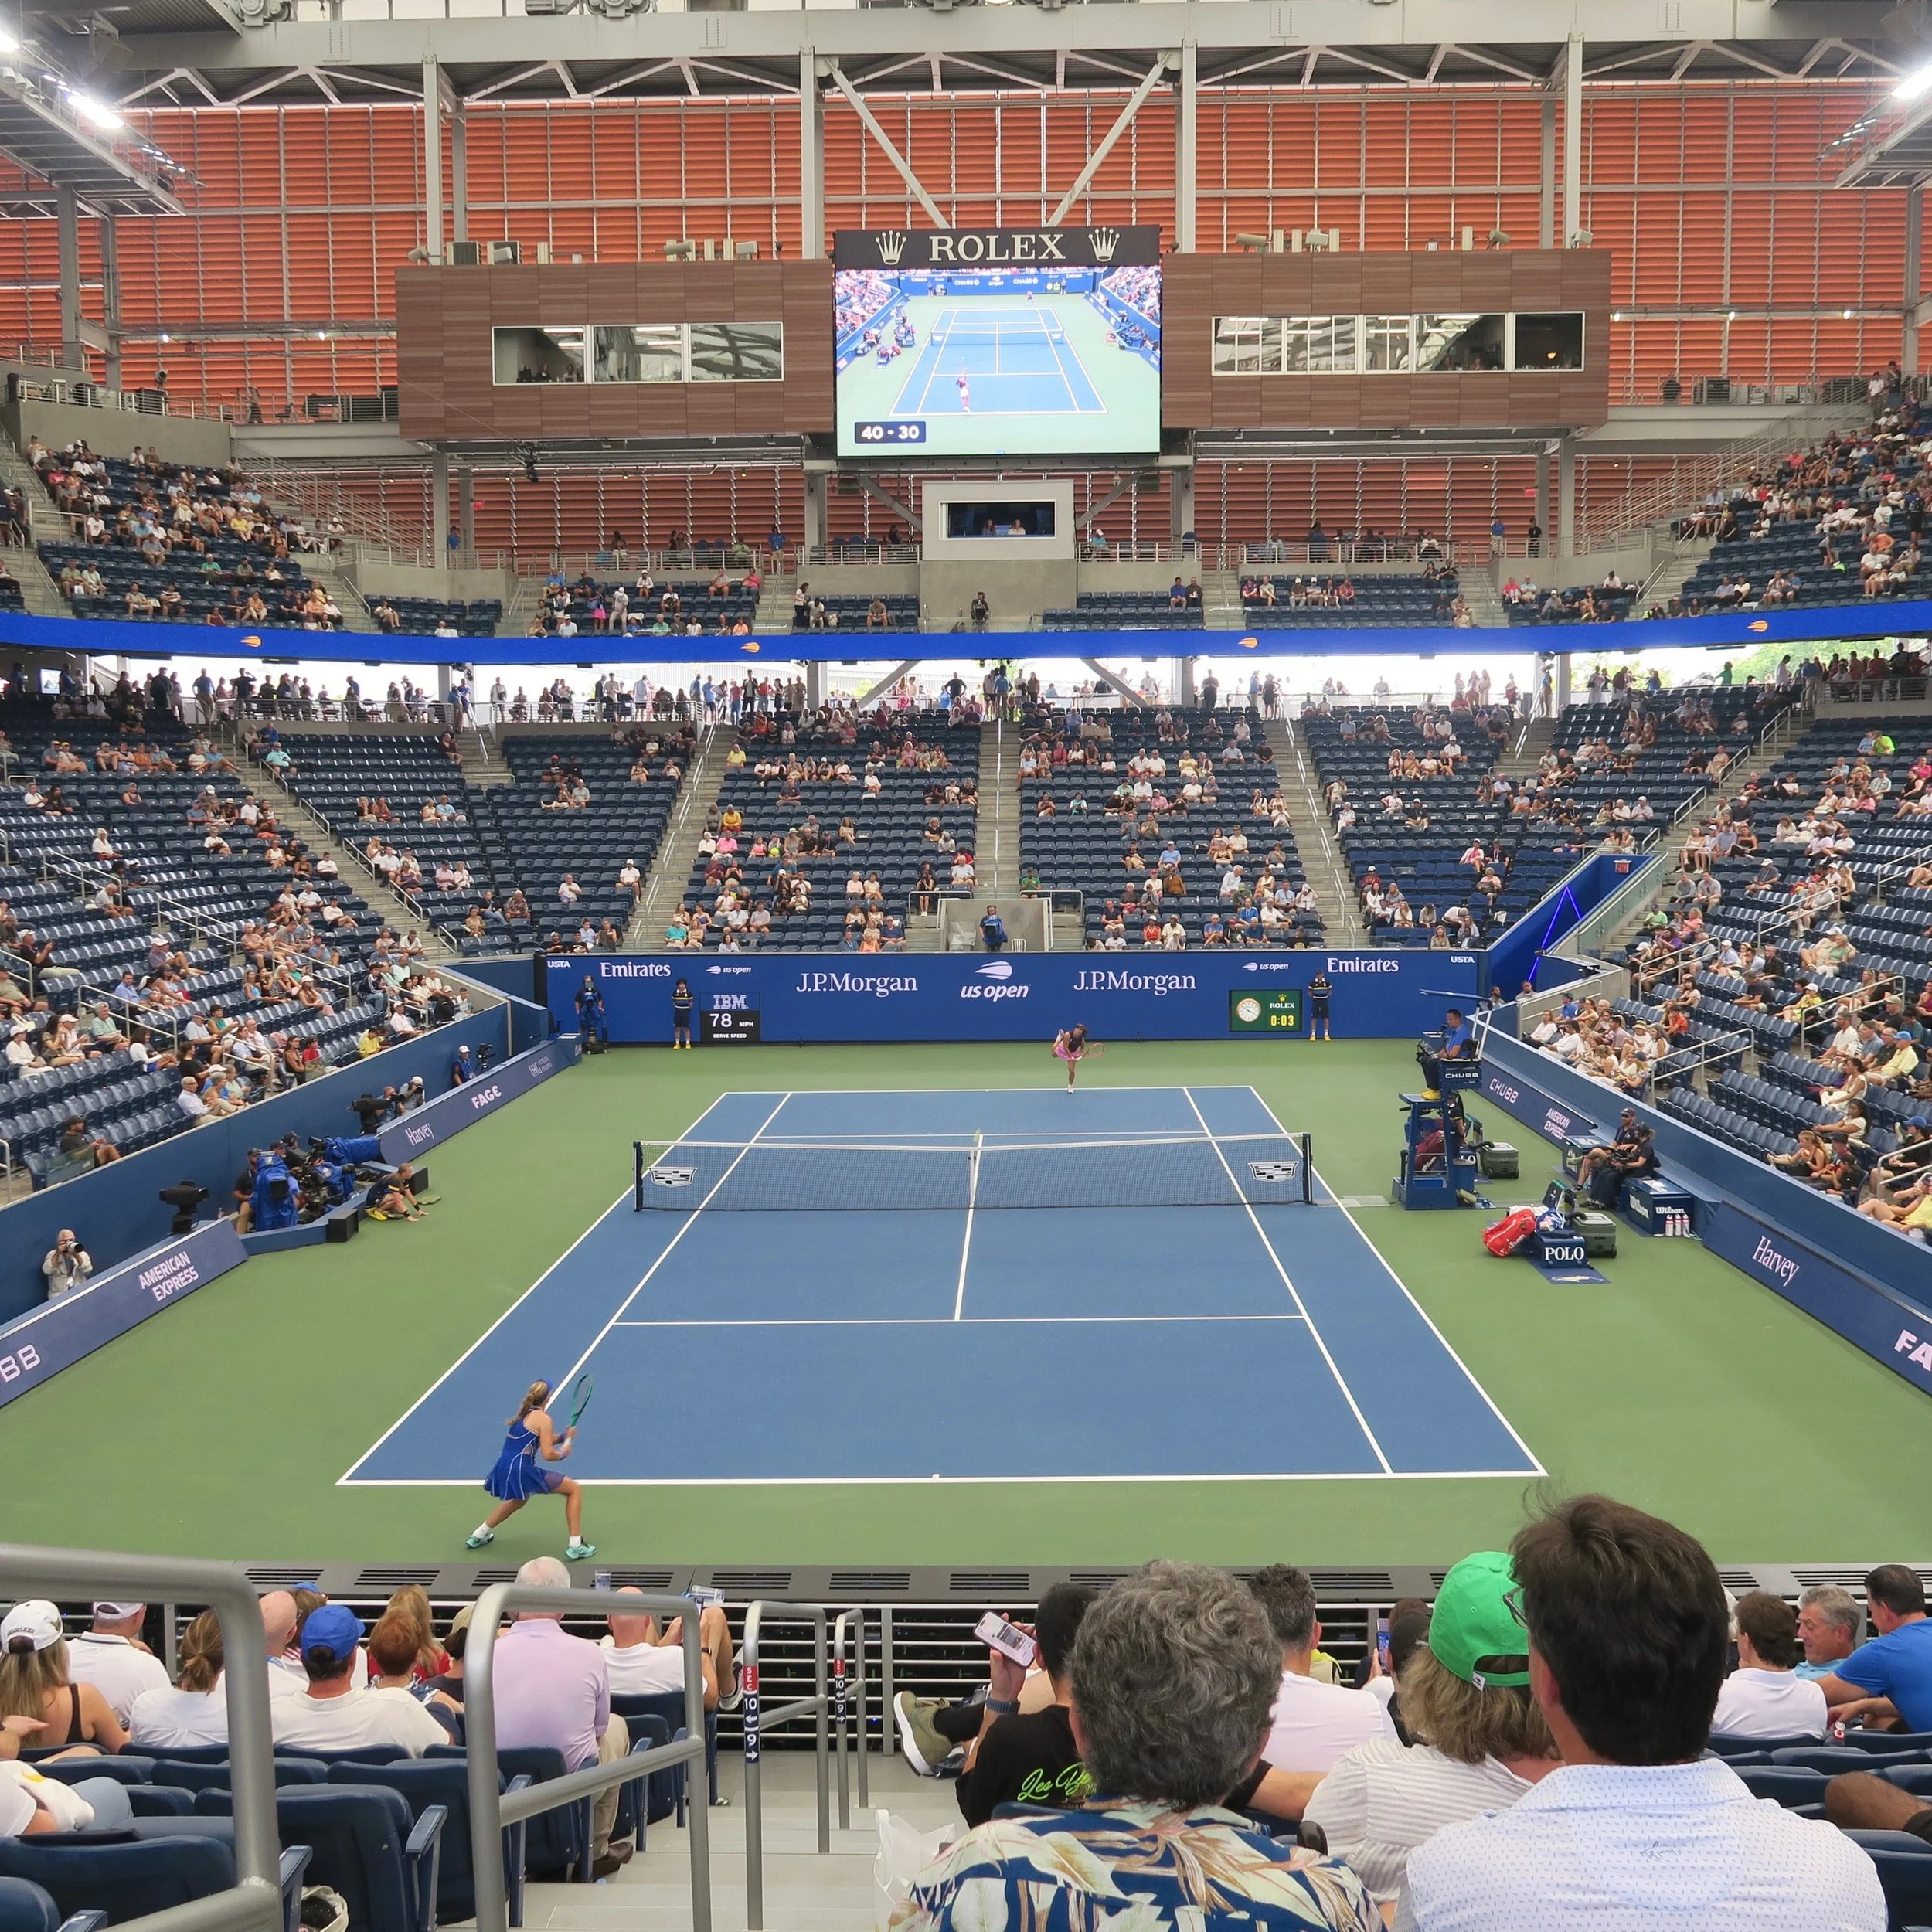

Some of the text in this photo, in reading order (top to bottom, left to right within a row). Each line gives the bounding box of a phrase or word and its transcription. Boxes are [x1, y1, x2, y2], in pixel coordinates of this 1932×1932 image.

[929, 234, 1066, 261] ROLEX
[861, 425, 883, 440] 40
[898, 425, 920, 440] 30
[600, 961, 672, 978] Emirates
[1327, 957, 1400, 973] Emirates
[796, 972, 918, 998] J.P.Morgan
[1073, 971, 1197, 996] J.P.Morgan
[713, 995, 747, 1009] IBM
[961, 985, 1029, 1002] us open
[709, 1013, 732, 1027] 78
[1270, 1015, 1294, 1026] 0:03
[1488, 1078, 1519, 1104] CHUBB
[1545, 1107, 1571, 1130] AMERICAN
[405, 1122, 436, 1147] Harvey
[1629, 1193, 1650, 1219] Wilson
[1655, 1206, 1685, 1214] Wilson
[1545, 1247, 1585, 1260] POLO
[1752, 1236, 1801, 1287] Harvey
[138, 1250, 191, 1290] AMERICAN
[151, 1265, 199, 1301] EXPRESS
[835, 1680, 844, 1689] 10
[744, 1698, 757, 1710] 10
[837, 1704, 844, 1713] 9
[747, 1733, 757, 1746] 9
